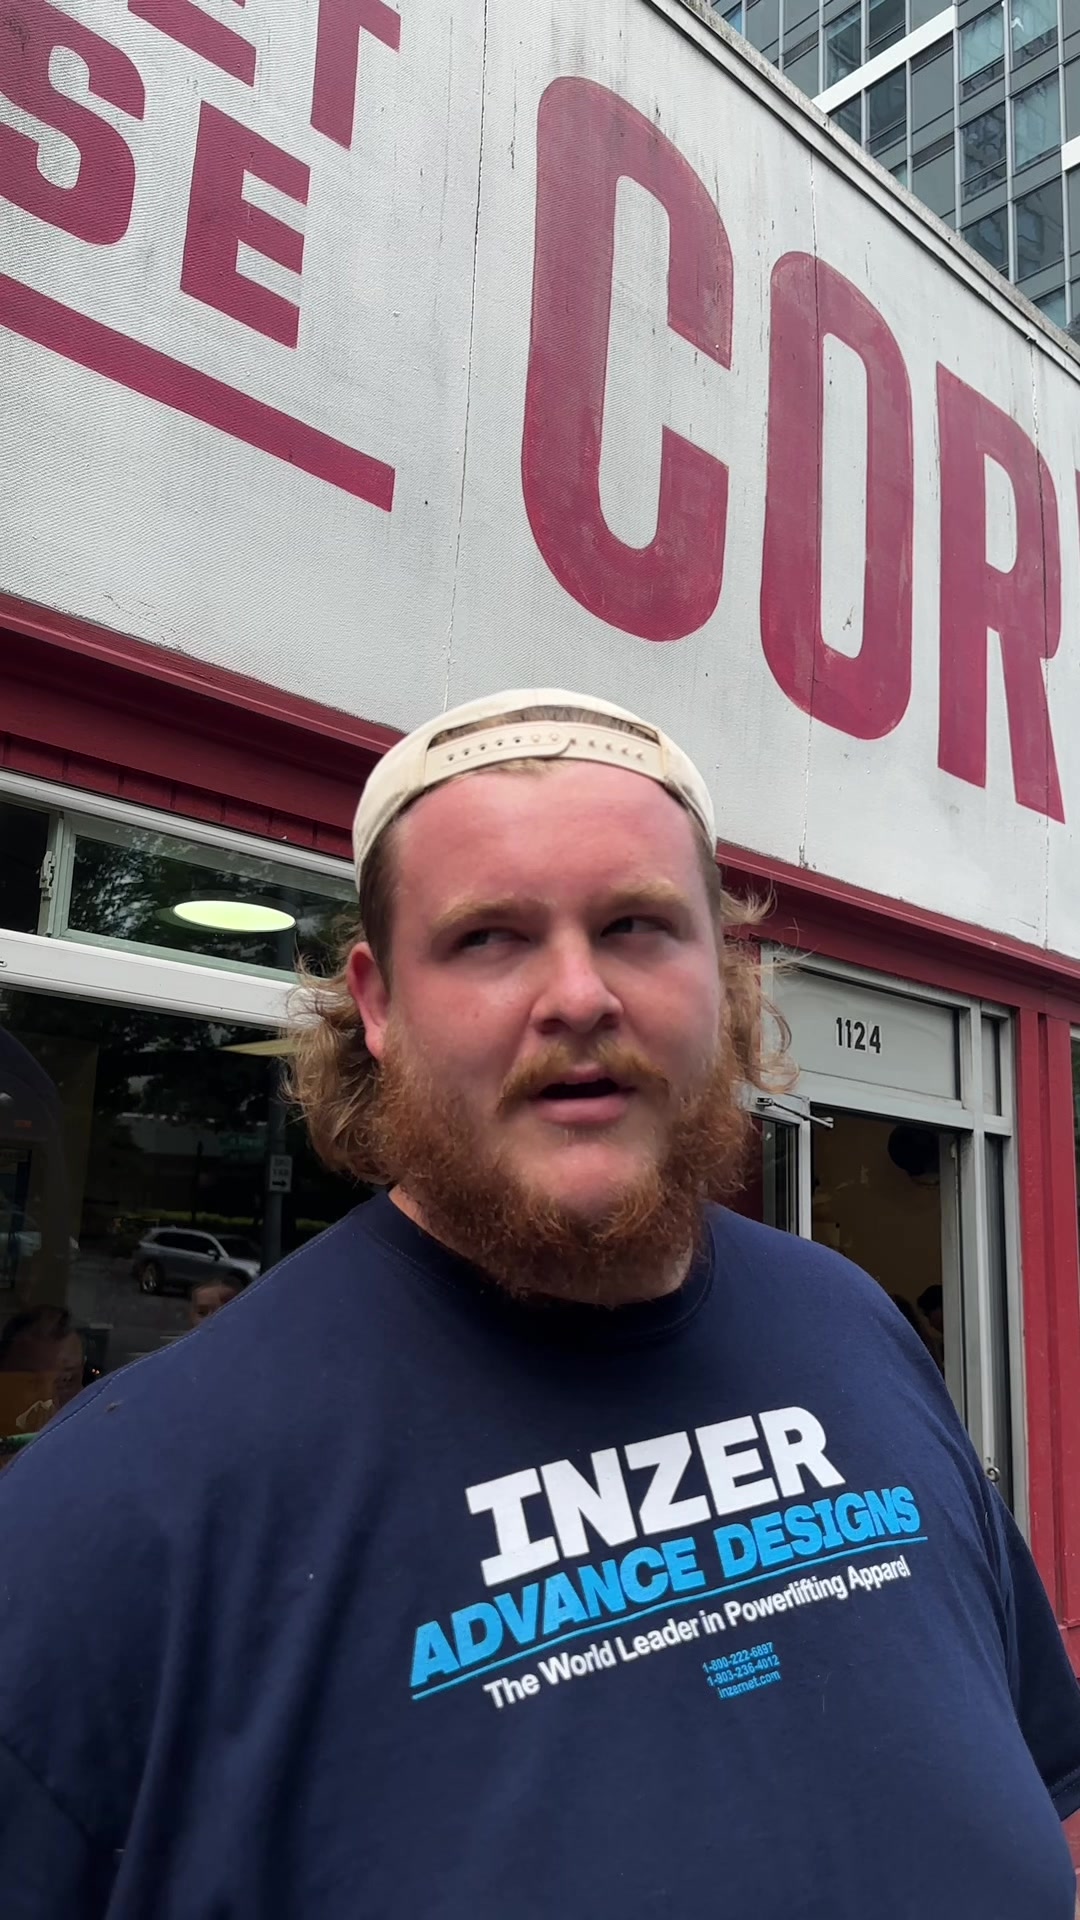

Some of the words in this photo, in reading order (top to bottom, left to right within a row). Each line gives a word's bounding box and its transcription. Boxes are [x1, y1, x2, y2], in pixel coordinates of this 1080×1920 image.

[127, 0, 402, 150] T
[521, 75, 1080, 825] COR
[835, 1016, 881, 1055] 1124
[465, 1405, 846, 1587] INZER
[410, 1537, 707, 1688] ADVANCE
[713, 1485, 922, 1579] DESIGNS
[483, 1668, 541, 1709] The
[538, 1641, 616, 1686] World
[616, 1617, 700, 1662] Leader
[698, 1609, 726, 1635] in
[725, 1573, 848, 1630] Powerlifting
[847, 1553, 912, 1595] Apparel
[702, 1641, 774, 1674] 1-800-222-6897
[706, 1654, 781, 1687] 1-903-236-4012
[716, 1670, 782, 1699] inzernet.com
